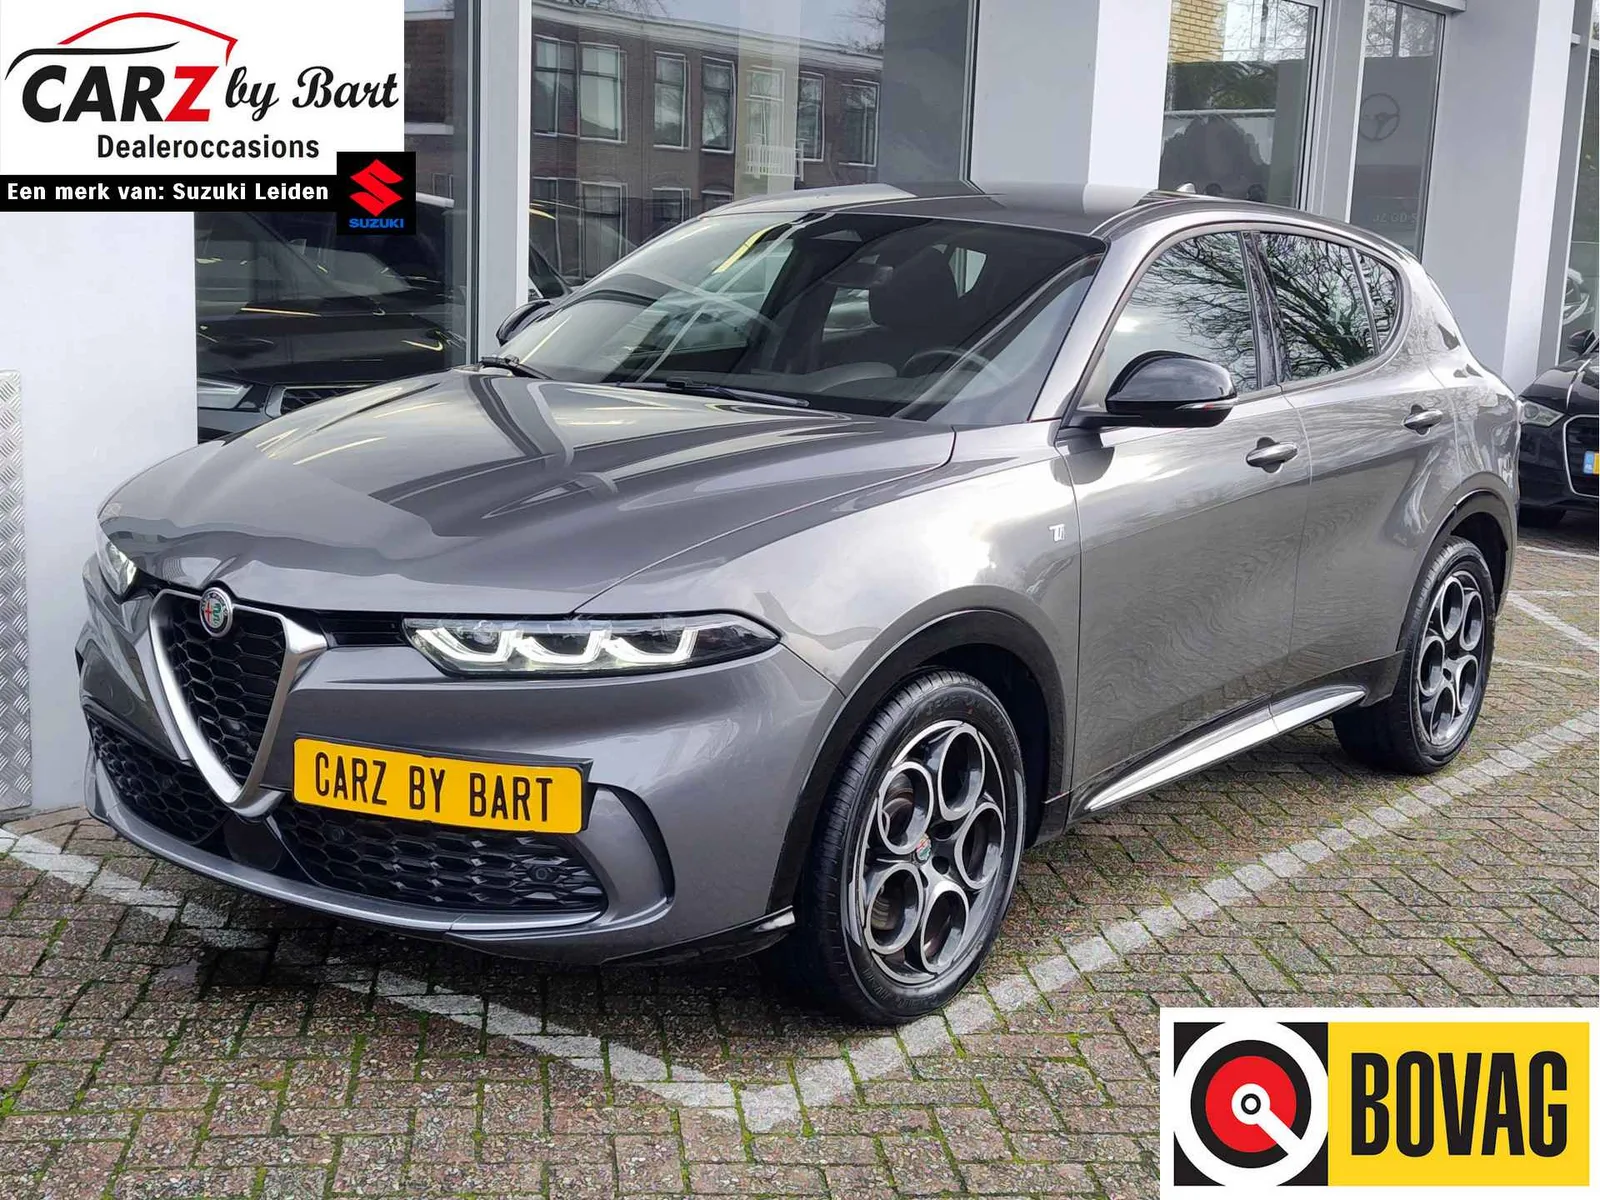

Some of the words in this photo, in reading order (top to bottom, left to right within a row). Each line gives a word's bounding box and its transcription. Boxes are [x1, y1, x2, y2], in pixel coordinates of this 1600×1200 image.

[315, 752, 387, 805] CARZ
[409, 765, 446, 813] BY
[469, 772, 553, 822] BART
